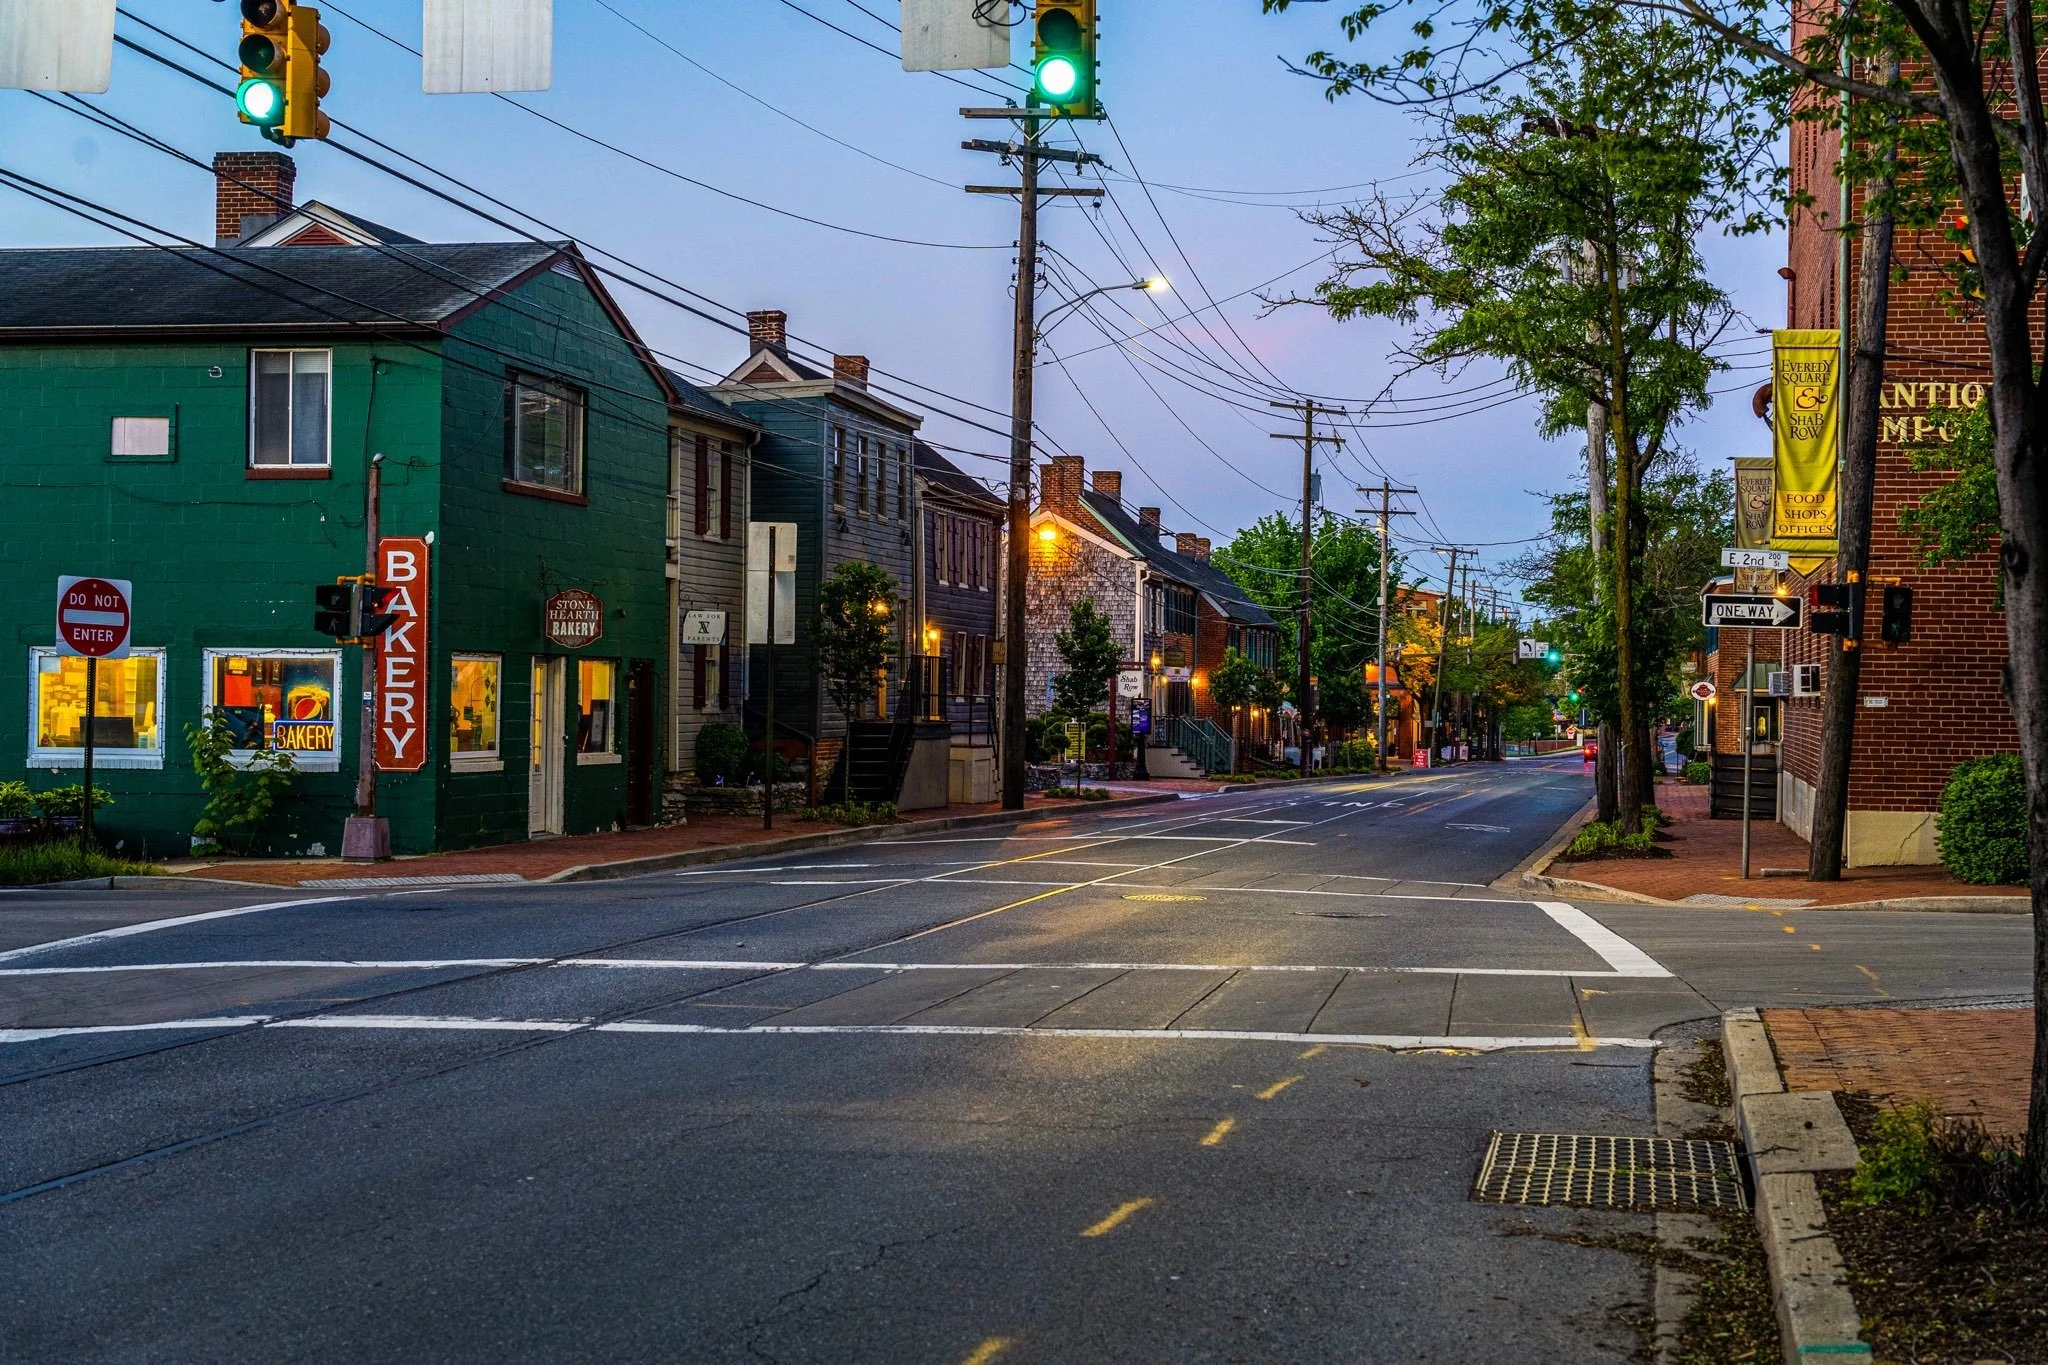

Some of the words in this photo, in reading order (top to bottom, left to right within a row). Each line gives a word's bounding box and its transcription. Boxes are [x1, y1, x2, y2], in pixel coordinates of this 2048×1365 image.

[1781, 360, 1834, 373] EVEREDY
[1782, 373, 1832, 386] SQUARE
[1796, 388, 1828, 409] &
[1790, 413, 1824, 425] SHAB
[1790, 426, 1824, 440] ROW
[1786, 495, 1825, 503] FOOD
[1746, 511, 1768, 520] SHAB
[1785, 510, 1827, 519] SHOPS
[1746, 520, 1767, 530] ROW
[1779, 525, 1833, 534] OFFICES
[1729, 552, 1740, 565] E.
[1743, 553, 1764, 566] 2nd
[1773, 560, 1780, 568] St
[69, 593, 87, 606] DO
[94, 594, 120, 608] NOT
[556, 600, 594, 610] STONE
[549, 609, 600, 620] HEARTH
[1716, 604, 1741, 617] ONE
[1747, 606, 1774, 618] WAY
[73, 628, 114, 642] ENTER
[553, 621, 595, 636] BAKERY
[384, 550, 418, 759] BAKERY
[1120, 675, 1138, 683] Shab
[276, 725, 334, 750] BAKERY
